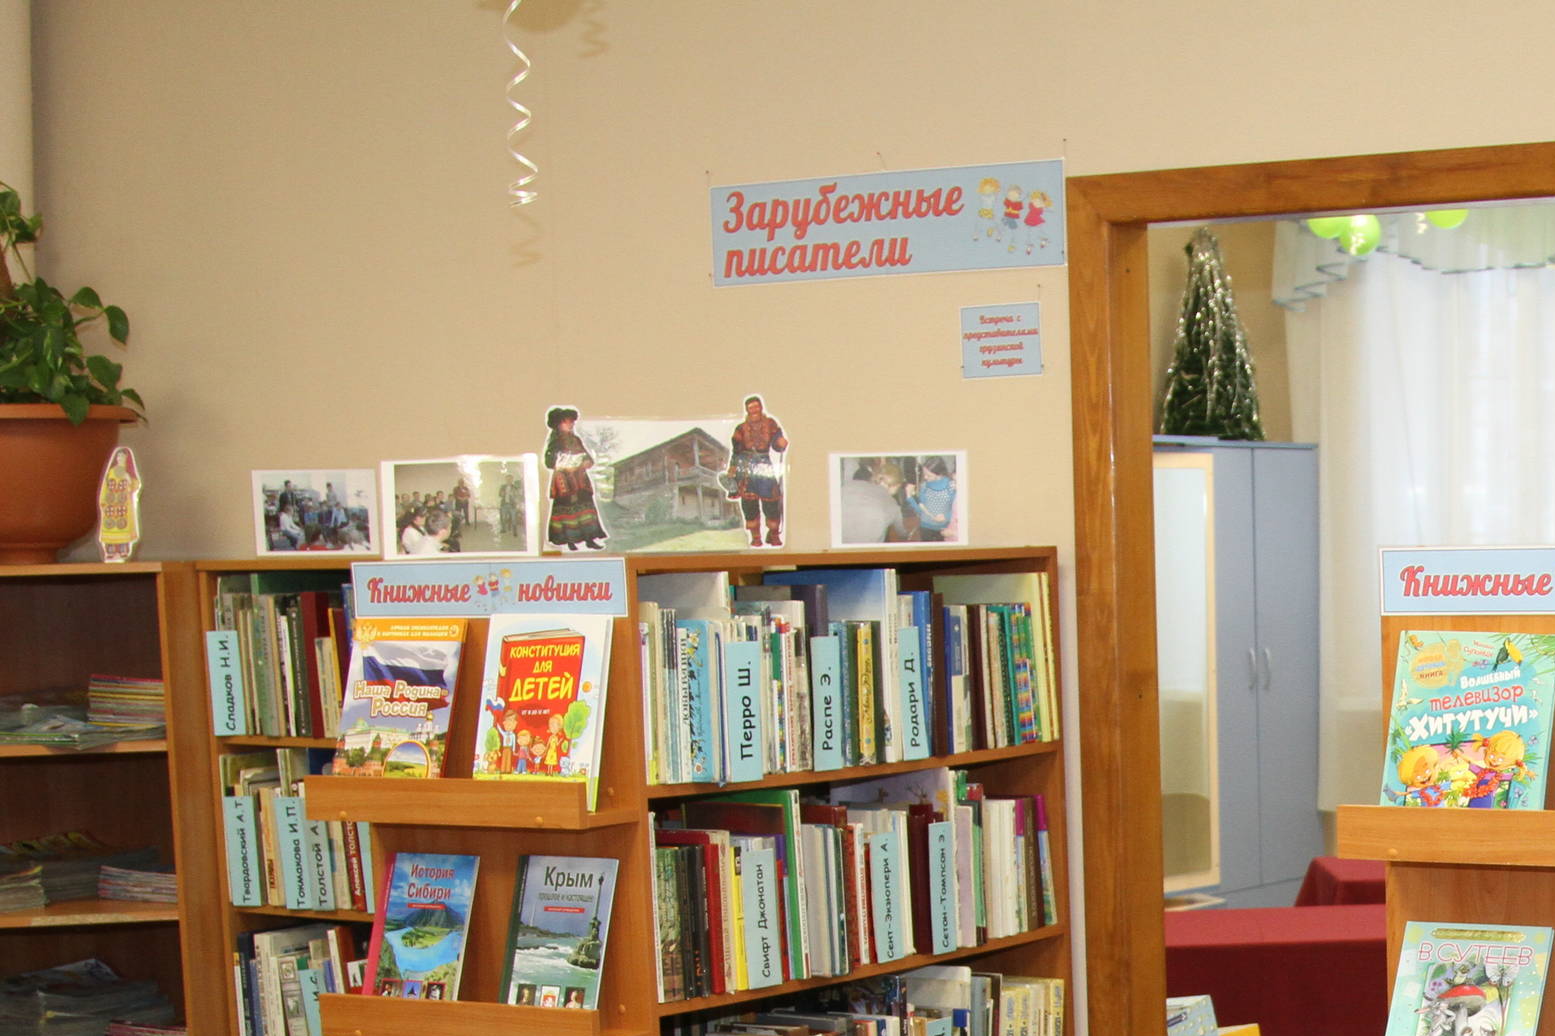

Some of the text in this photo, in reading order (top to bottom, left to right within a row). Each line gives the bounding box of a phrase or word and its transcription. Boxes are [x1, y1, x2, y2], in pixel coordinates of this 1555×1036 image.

[722, 182, 964, 240] Зарубежные
[723, 236, 913, 277] писатели
[367, 574, 613, 605] Книжные новинки
[1399, 565, 1553, 597] Книжные
[510, 644, 580, 658] КОНСТИТУЦИЯ
[532, 660, 553, 673] ДЛЯ
[353, 680, 441, 700] Наша Родина
[508, 672, 573, 702] ДЕТЕЙ
[1460, 666, 1521, 689] Волшебный
[224, 674, 236, 731] Сладков
[370, 697, 428, 718] Россия
[738, 661, 756, 760] Перро Ш.
[1429, 685, 1524, 712] телевизор
[822, 695, 833, 750] Распе
[908, 682, 921, 747] Родари
[1405, 704, 1539, 741] «ХИТУТУЧИ»
[237, 827, 252, 903] Твардовский
[295, 838, 306, 907] Токмакова
[312, 843, 327, 906] Толстой
[410, 864, 456, 880] История
[544, 866, 593, 891] Крым
[407, 882, 451, 899] Сибири
[754, 864, 771, 978] Свифт Джонатан
[1437, 943, 1534, 966] СУТЕЕВ
